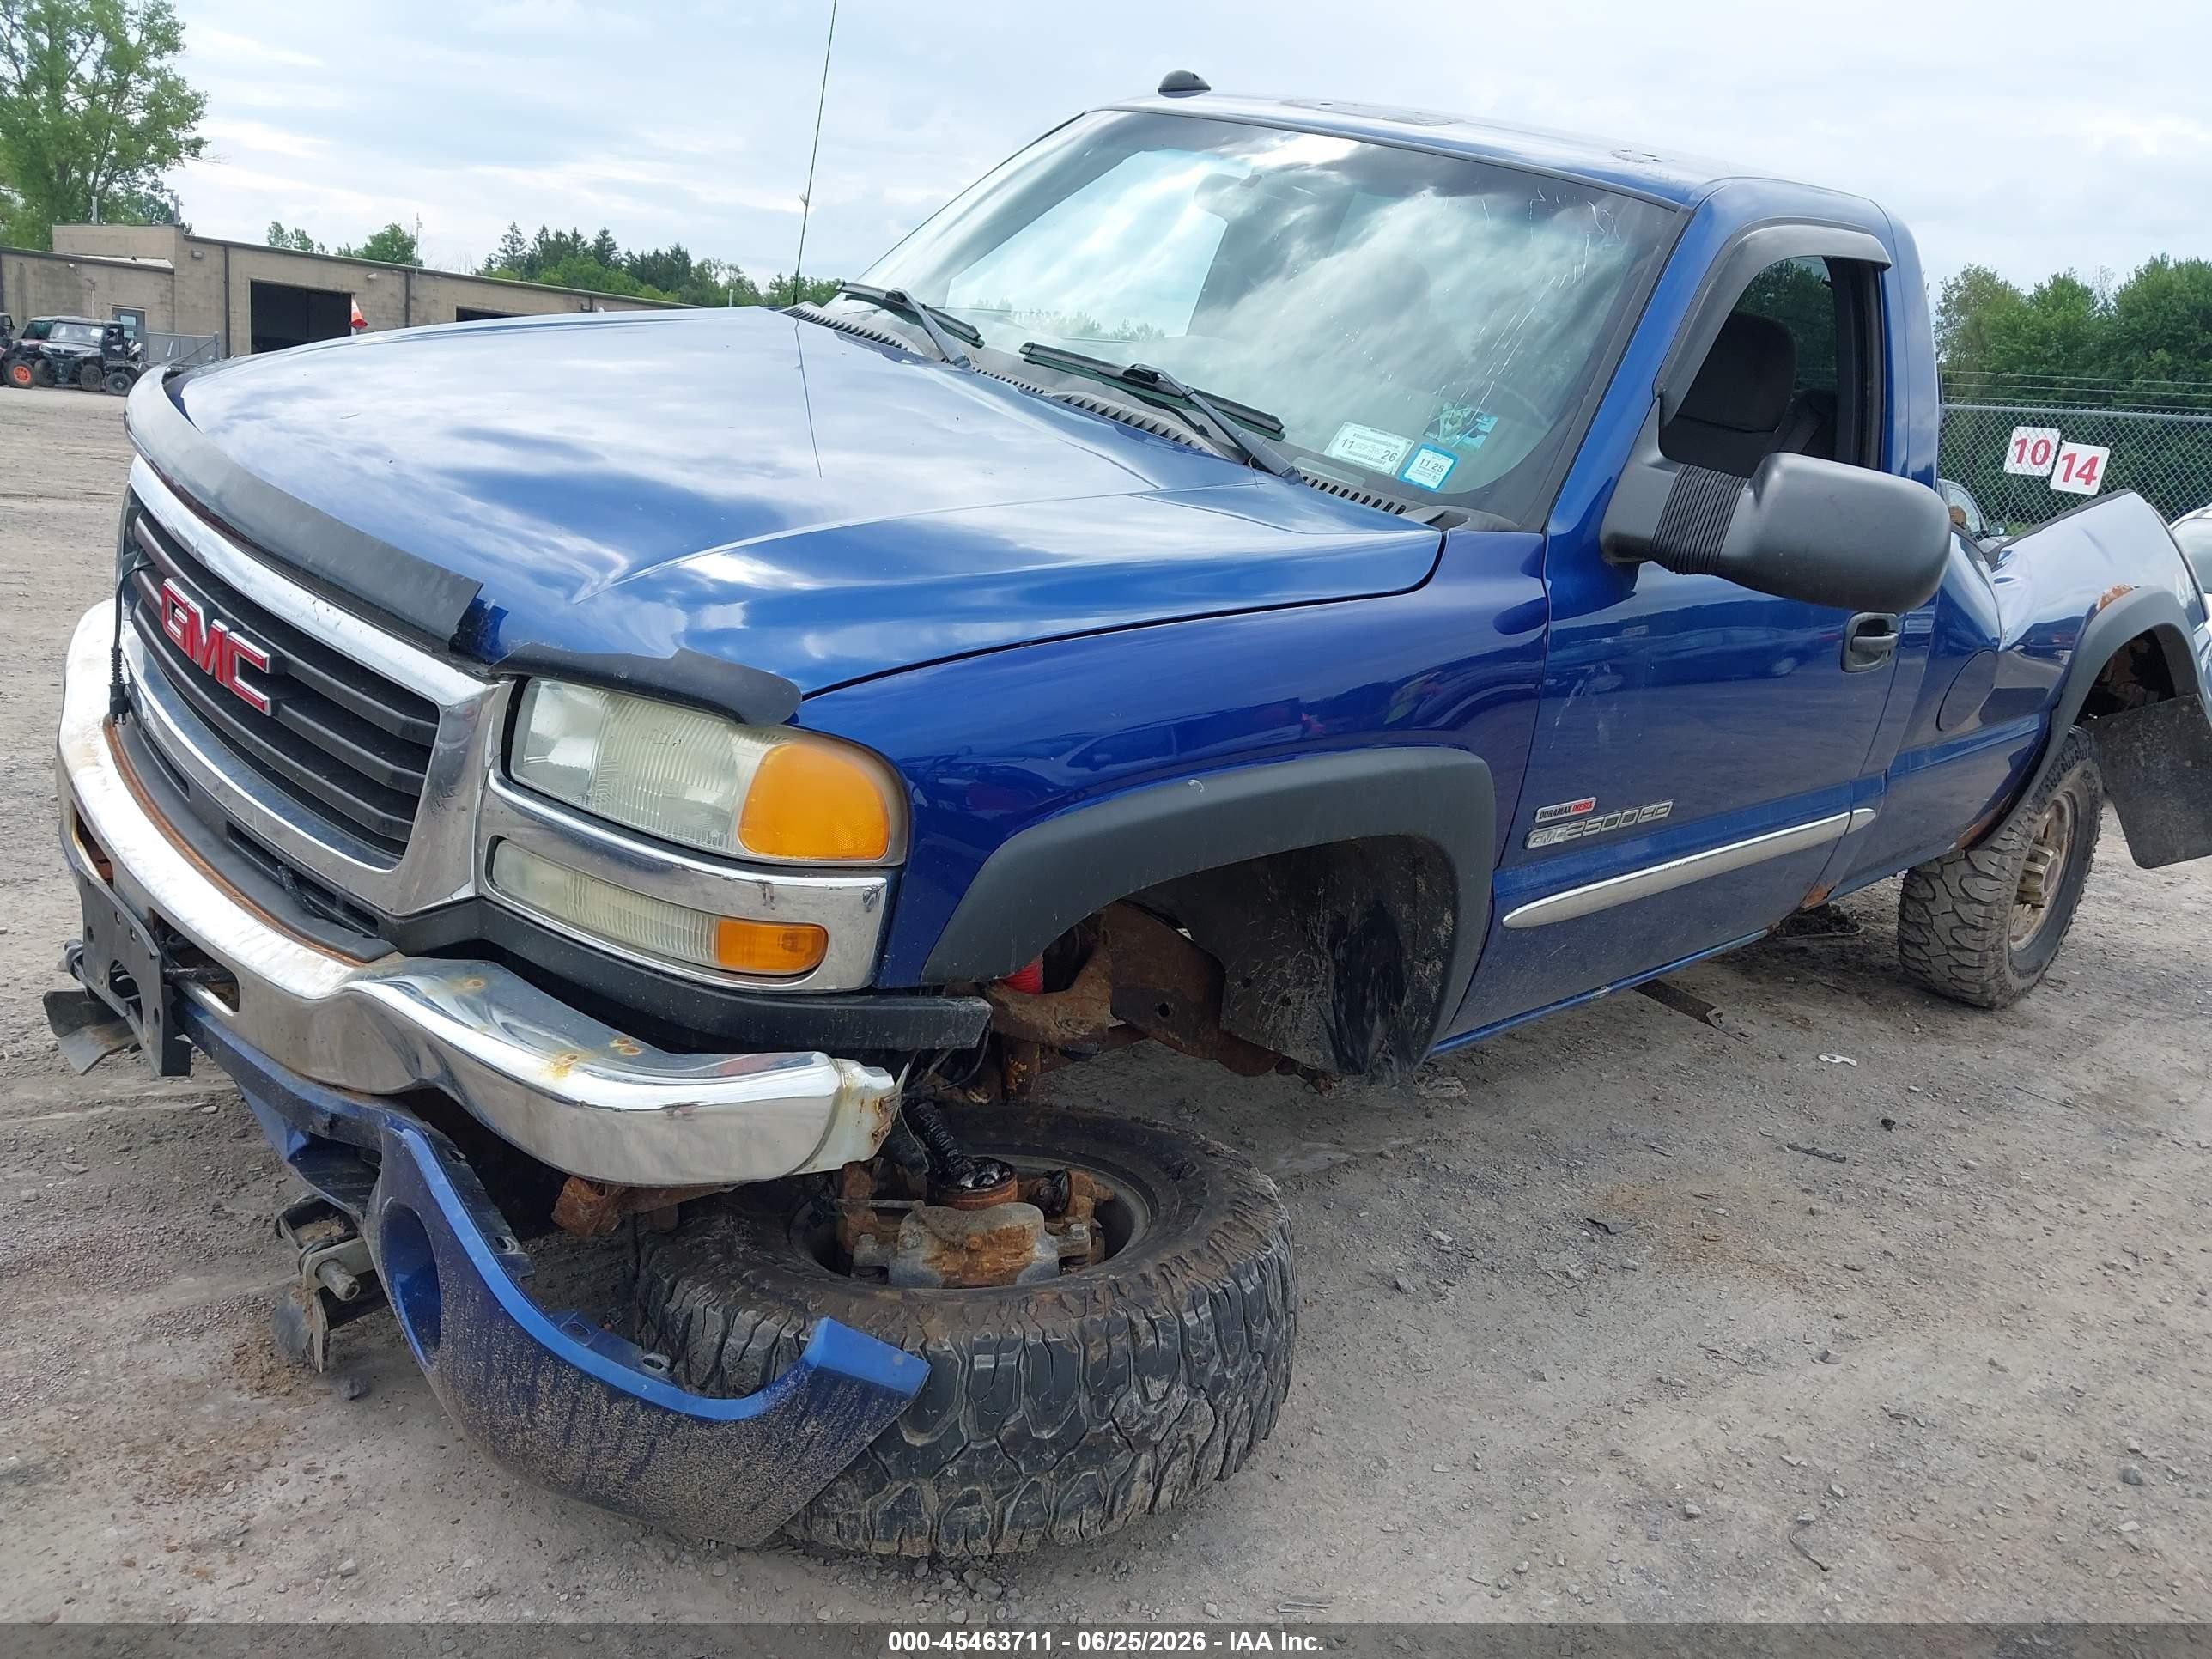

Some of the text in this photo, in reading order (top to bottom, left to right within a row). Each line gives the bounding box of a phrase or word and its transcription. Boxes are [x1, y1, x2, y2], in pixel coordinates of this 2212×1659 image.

[1341, 438, 1355, 450] 11
[1381, 449, 1398, 462] 26
[2014, 438, 2051, 466] 10
[2062, 453, 2100, 486] 14
[161, 577, 272, 717] GMC
[1538, 799, 1595, 820] DURAMAX DIESEL
